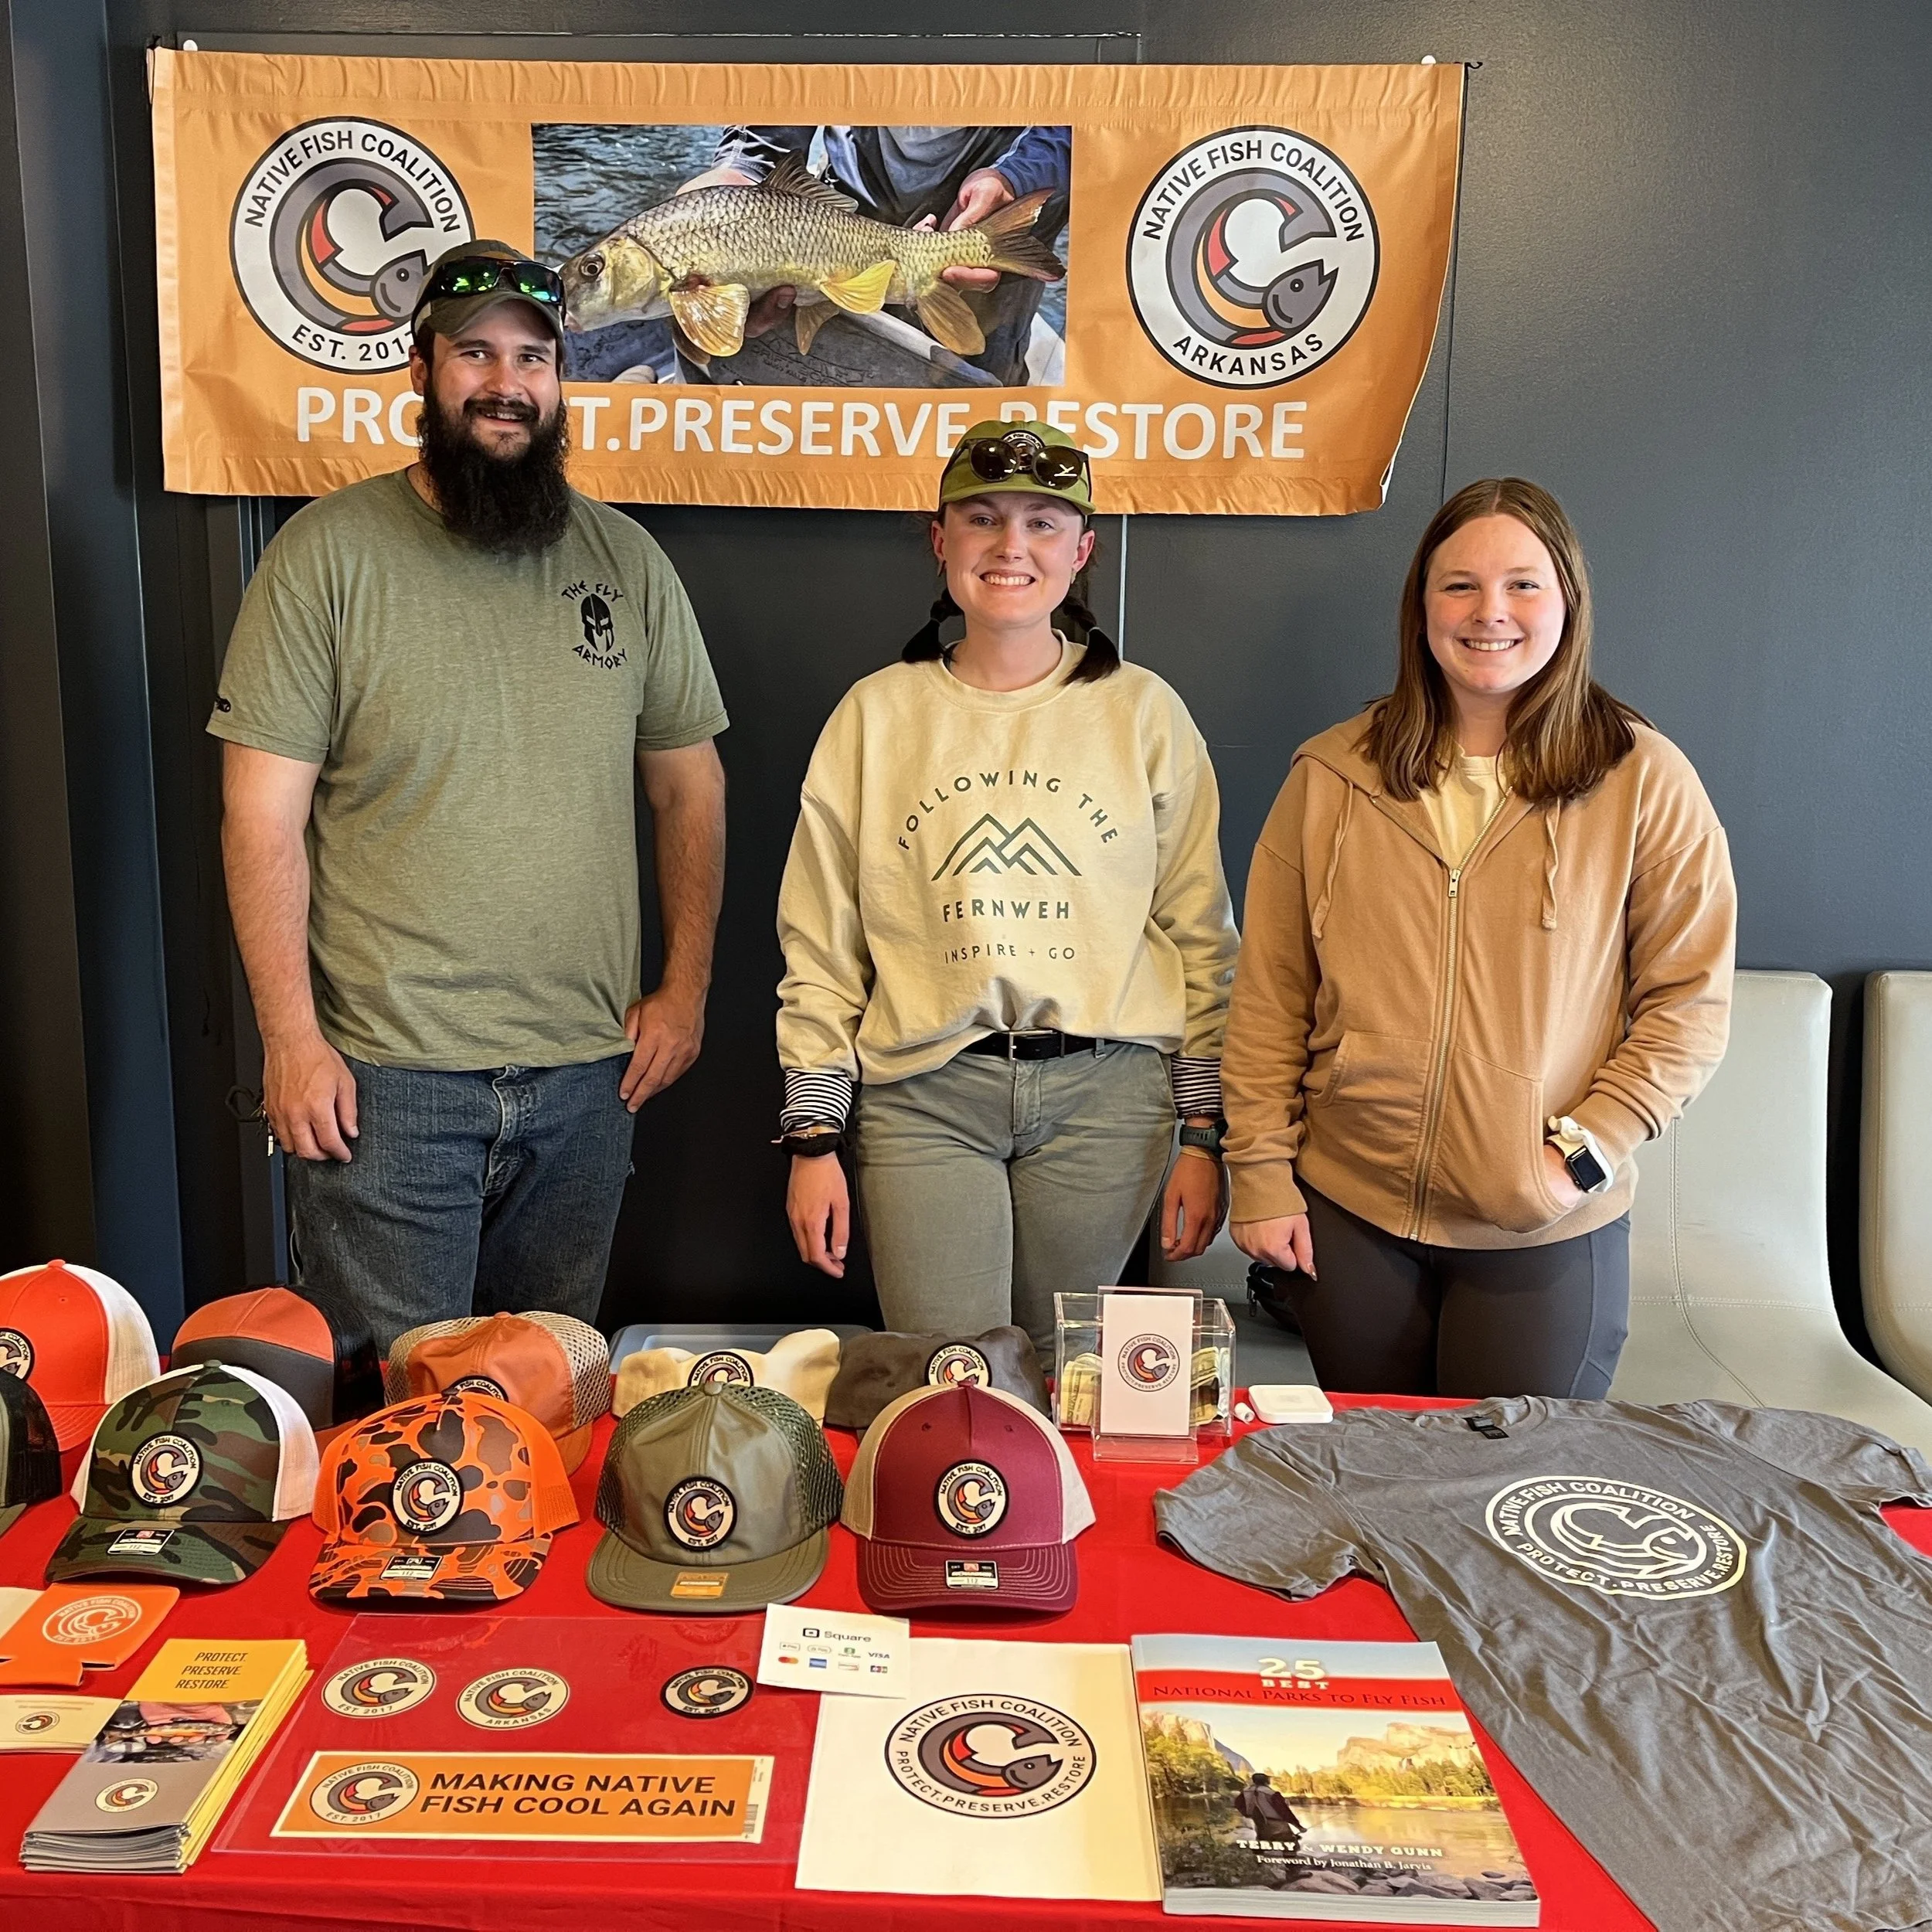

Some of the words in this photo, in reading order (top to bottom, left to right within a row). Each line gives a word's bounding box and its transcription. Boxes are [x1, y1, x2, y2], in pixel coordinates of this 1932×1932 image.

[245, 148, 303, 227] NATIVE
[300, 131, 353, 159] FISH
[361, 133, 461, 233] COALITION
[1142, 158, 1206, 240] NATIVE
[1206, 139, 1262, 169] FISH
[1270, 141, 1365, 242] COALITION
[291, 324, 347, 360] EST.
[1172, 333, 1324, 376] ARKANSAS
[561, 580, 589, 600] THE
[595, 583, 624, 602] FLY
[572, 645, 628, 670] ARMORY
[898, 770, 1062, 850] FOLLOWING
[1078, 793, 1118, 844] THE
[942, 899, 1070, 923] FERNWEH
[944, 943, 1017, 964] INSPIRE
[1049, 947, 1075, 960] GO
[1499, 1495, 1530, 1536] NATIVE
[1524, 1481, 1567, 1502] FISH
[1569, 1481, 1696, 1521] COALITION
[824, 1631, 872, 1642] Square
[336, 1663, 371, 1681] NATIVE
[399, 1661, 430, 1685] COALITION
[1258, 1658, 1326, 1681] 25
[464, 1681, 487, 1702] NATIVE
[486, 1672, 509, 1682] FISH
[512, 1670, 560, 1686] COALITION
[1153, 1686, 1253, 1699] NATIONAL
[1262, 1689, 1321, 1702] PARKS
[1362, 1693, 1393, 1706] FLY
[1400, 1695, 1447, 1706] FISH
[1260, 1679, 1329, 1690] BEST
[362, 1706, 393, 1714] 2017
[485, 1707, 552, 1726] ARKANSAS
[899, 1706, 950, 1743] NATIVE
[951, 1699, 994, 1712] FISH
[1000, 1700, 1083, 1747] COALITION
[321, 1768, 355, 1788] NATIVE
[382, 1765, 415, 1789] COALITION
[429, 1772, 576, 1792] MAKING
[584, 1775, 716, 1794] NATIVE
[352, 1812, 381, 1822] 2017
[420, 1794, 505, 1815] FISH
[512, 1796, 611, 1816] COOL
[618, 1798, 736, 1818] AGAIN
[1236, 1839, 1297, 1852] TERRY
[1319, 1843, 1386, 1855] WENDY
[1390, 1846, 1444, 1857] GUNN
[1256, 1855, 1311, 1866] Foreword
[1314, 1856, 1327, 1869] by
[1330, 1859, 1381, 1869] Jonathan
[1383, 1861, 1396, 1869] B.
[1399, 1861, 1433, 1871] Jarvis
